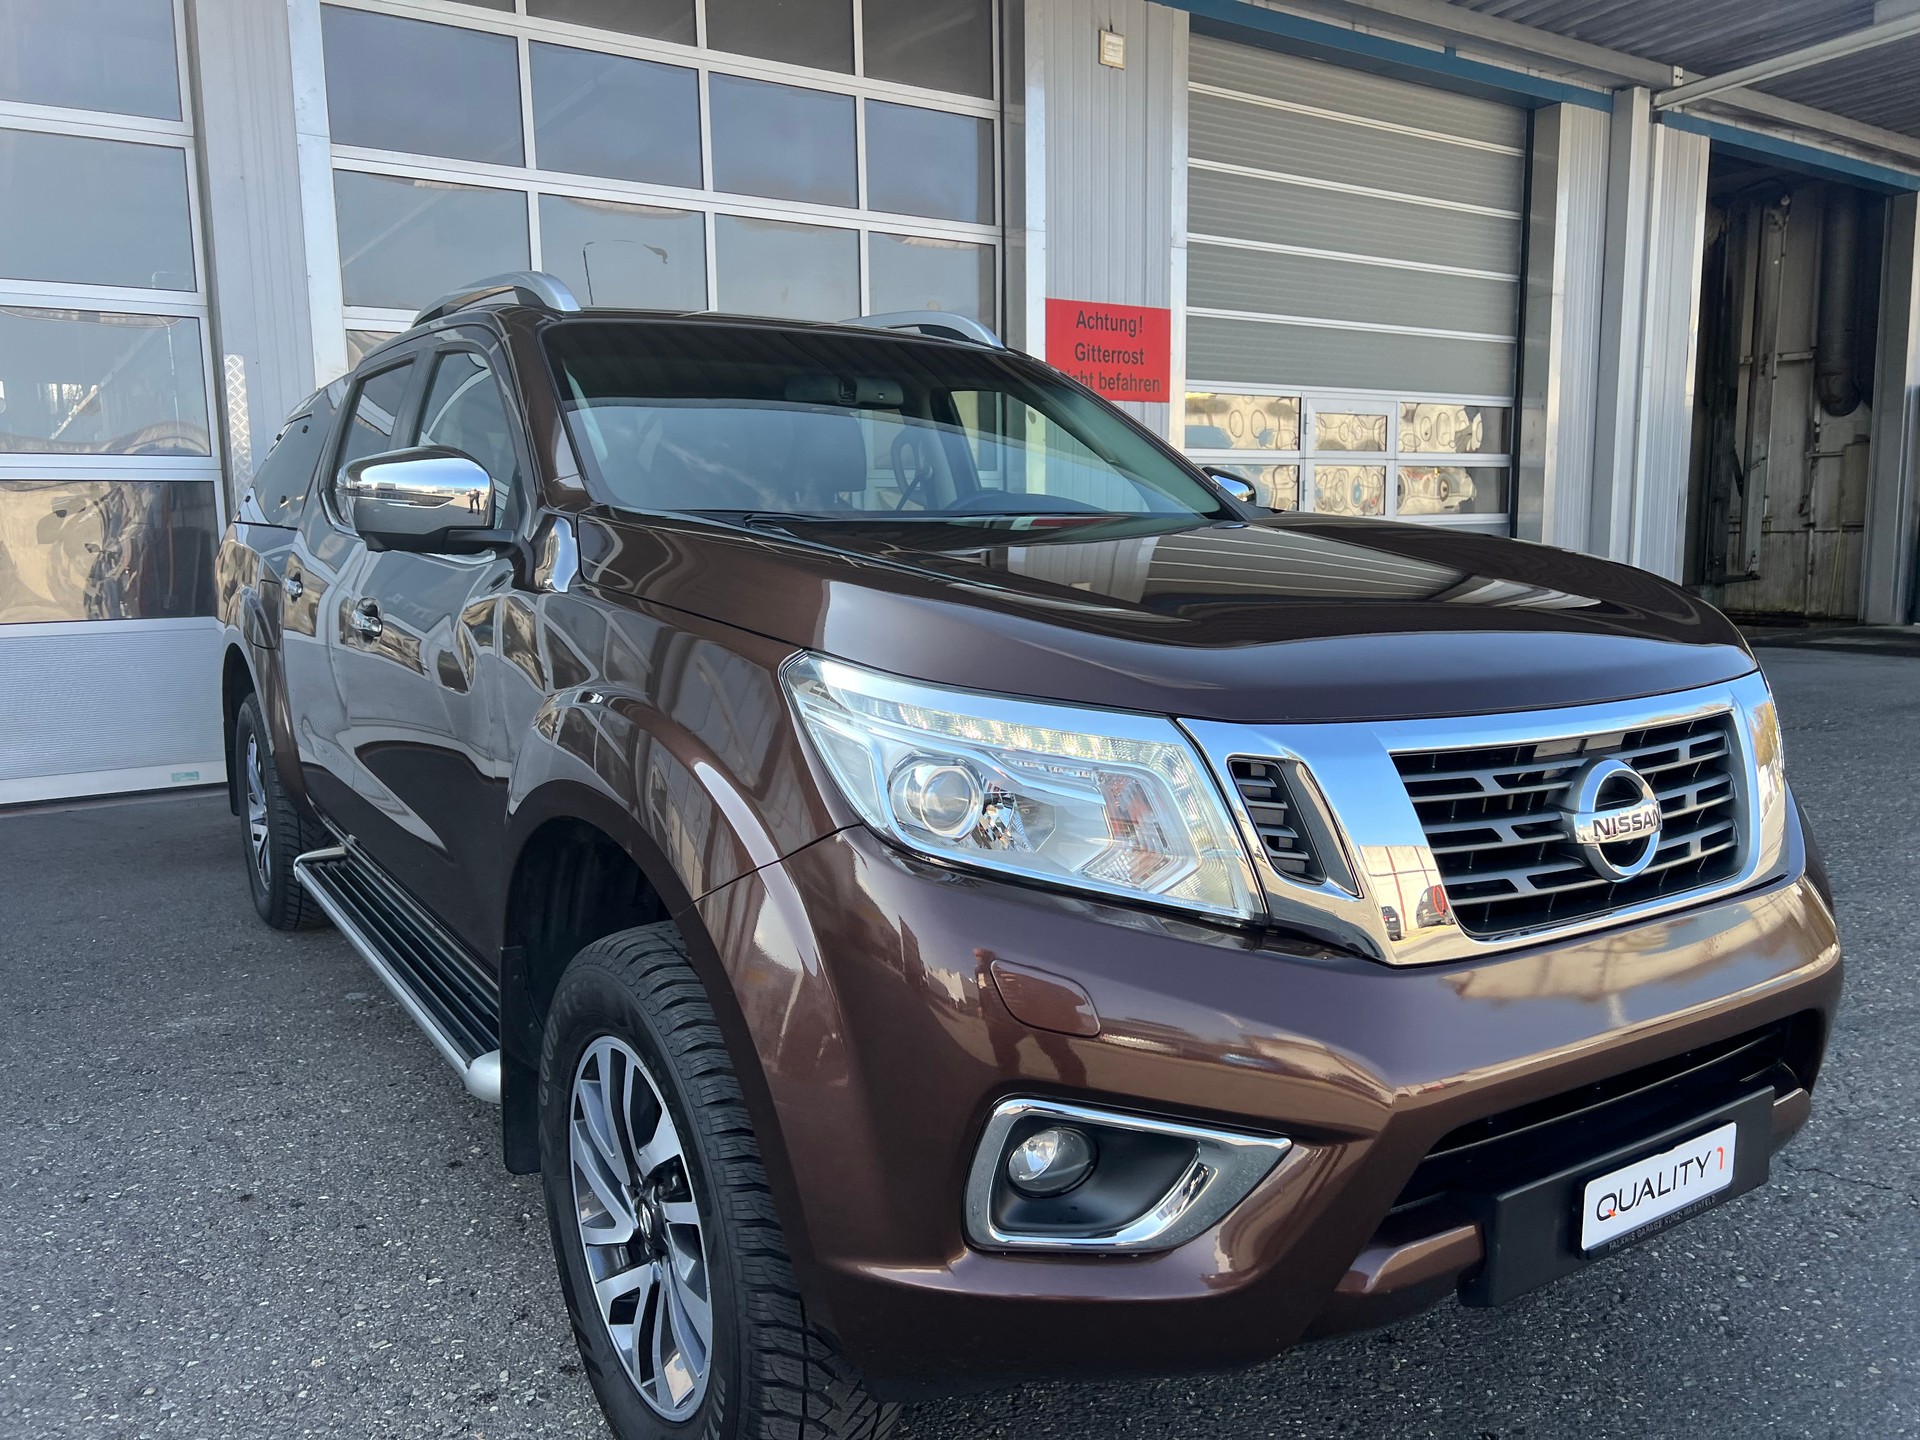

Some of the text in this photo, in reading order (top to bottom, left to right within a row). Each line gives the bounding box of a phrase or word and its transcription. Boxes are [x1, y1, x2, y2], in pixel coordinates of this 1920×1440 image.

[1076, 310, 1143, 338] Achtung!
[1074, 342, 1145, 365] Gitterrost
[1098, 371, 1161, 392] befahren
[1592, 808, 1661, 837] NISSAN
